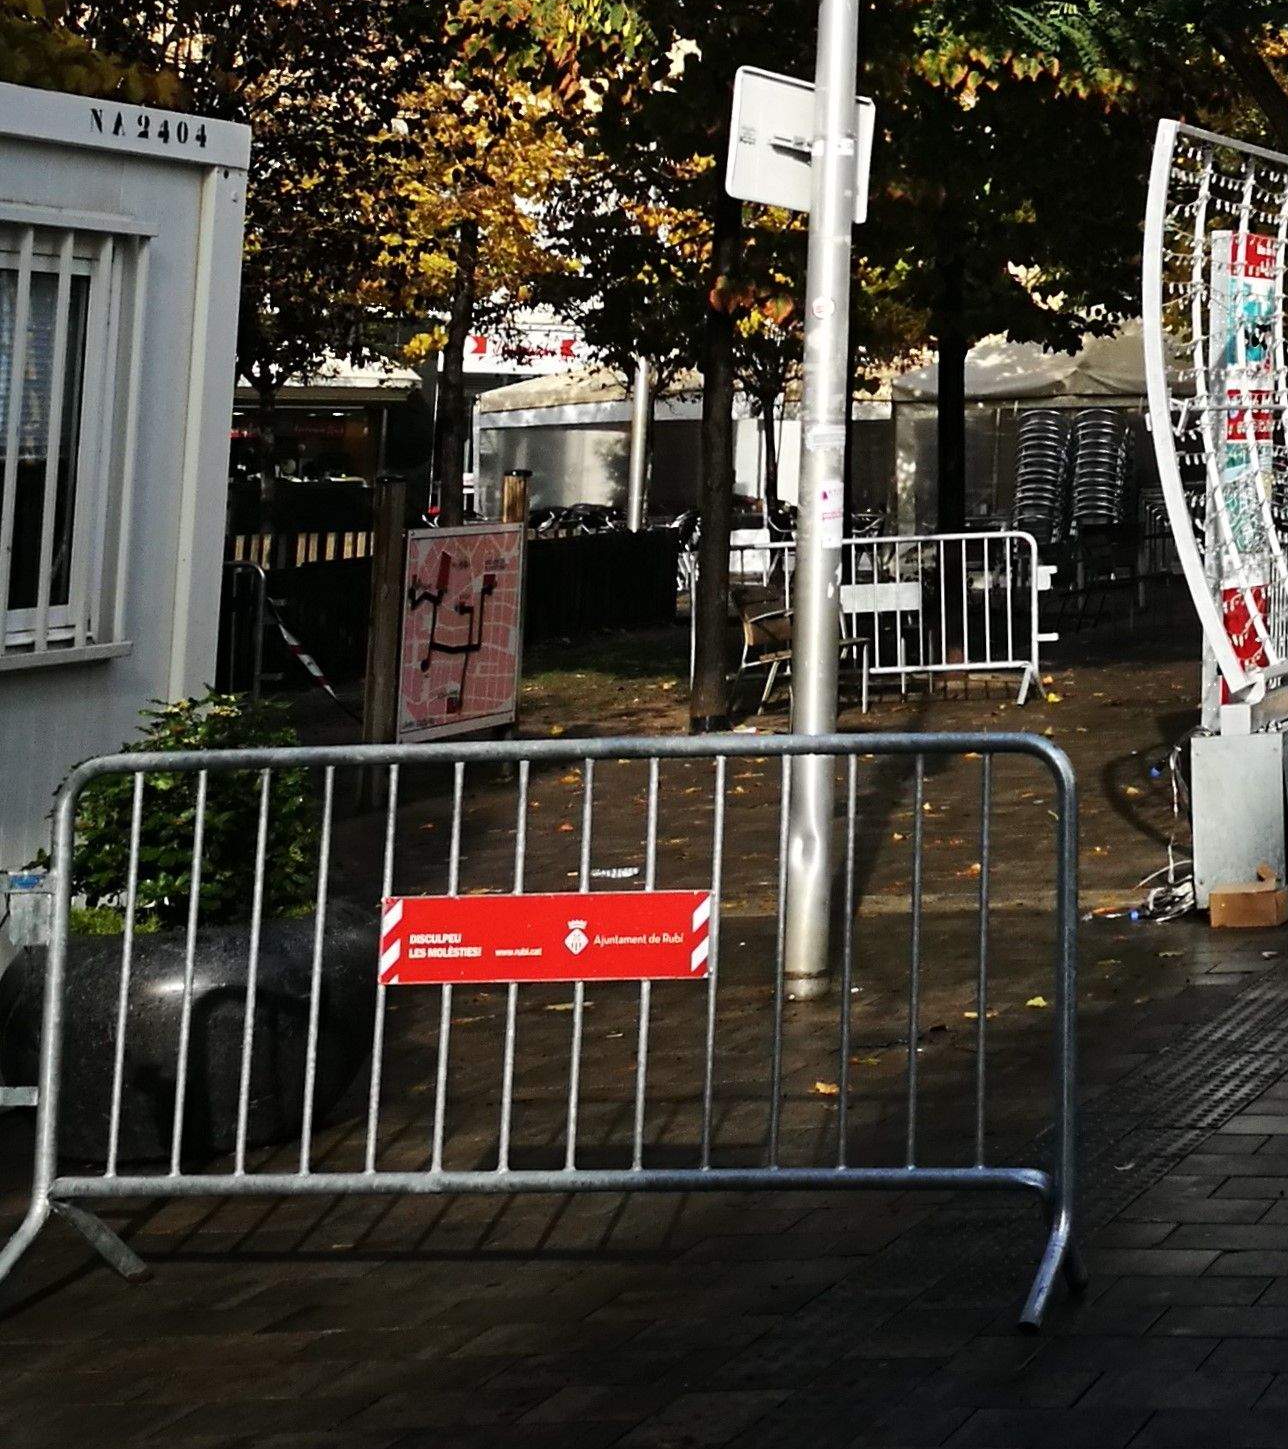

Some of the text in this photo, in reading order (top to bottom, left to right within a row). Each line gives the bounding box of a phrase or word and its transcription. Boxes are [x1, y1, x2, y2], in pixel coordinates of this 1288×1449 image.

[409, 933, 462, 945] DISCULPEU
[594, 932, 684, 946] Ajuntament de Rubí
[408, 948, 426, 959] LES
